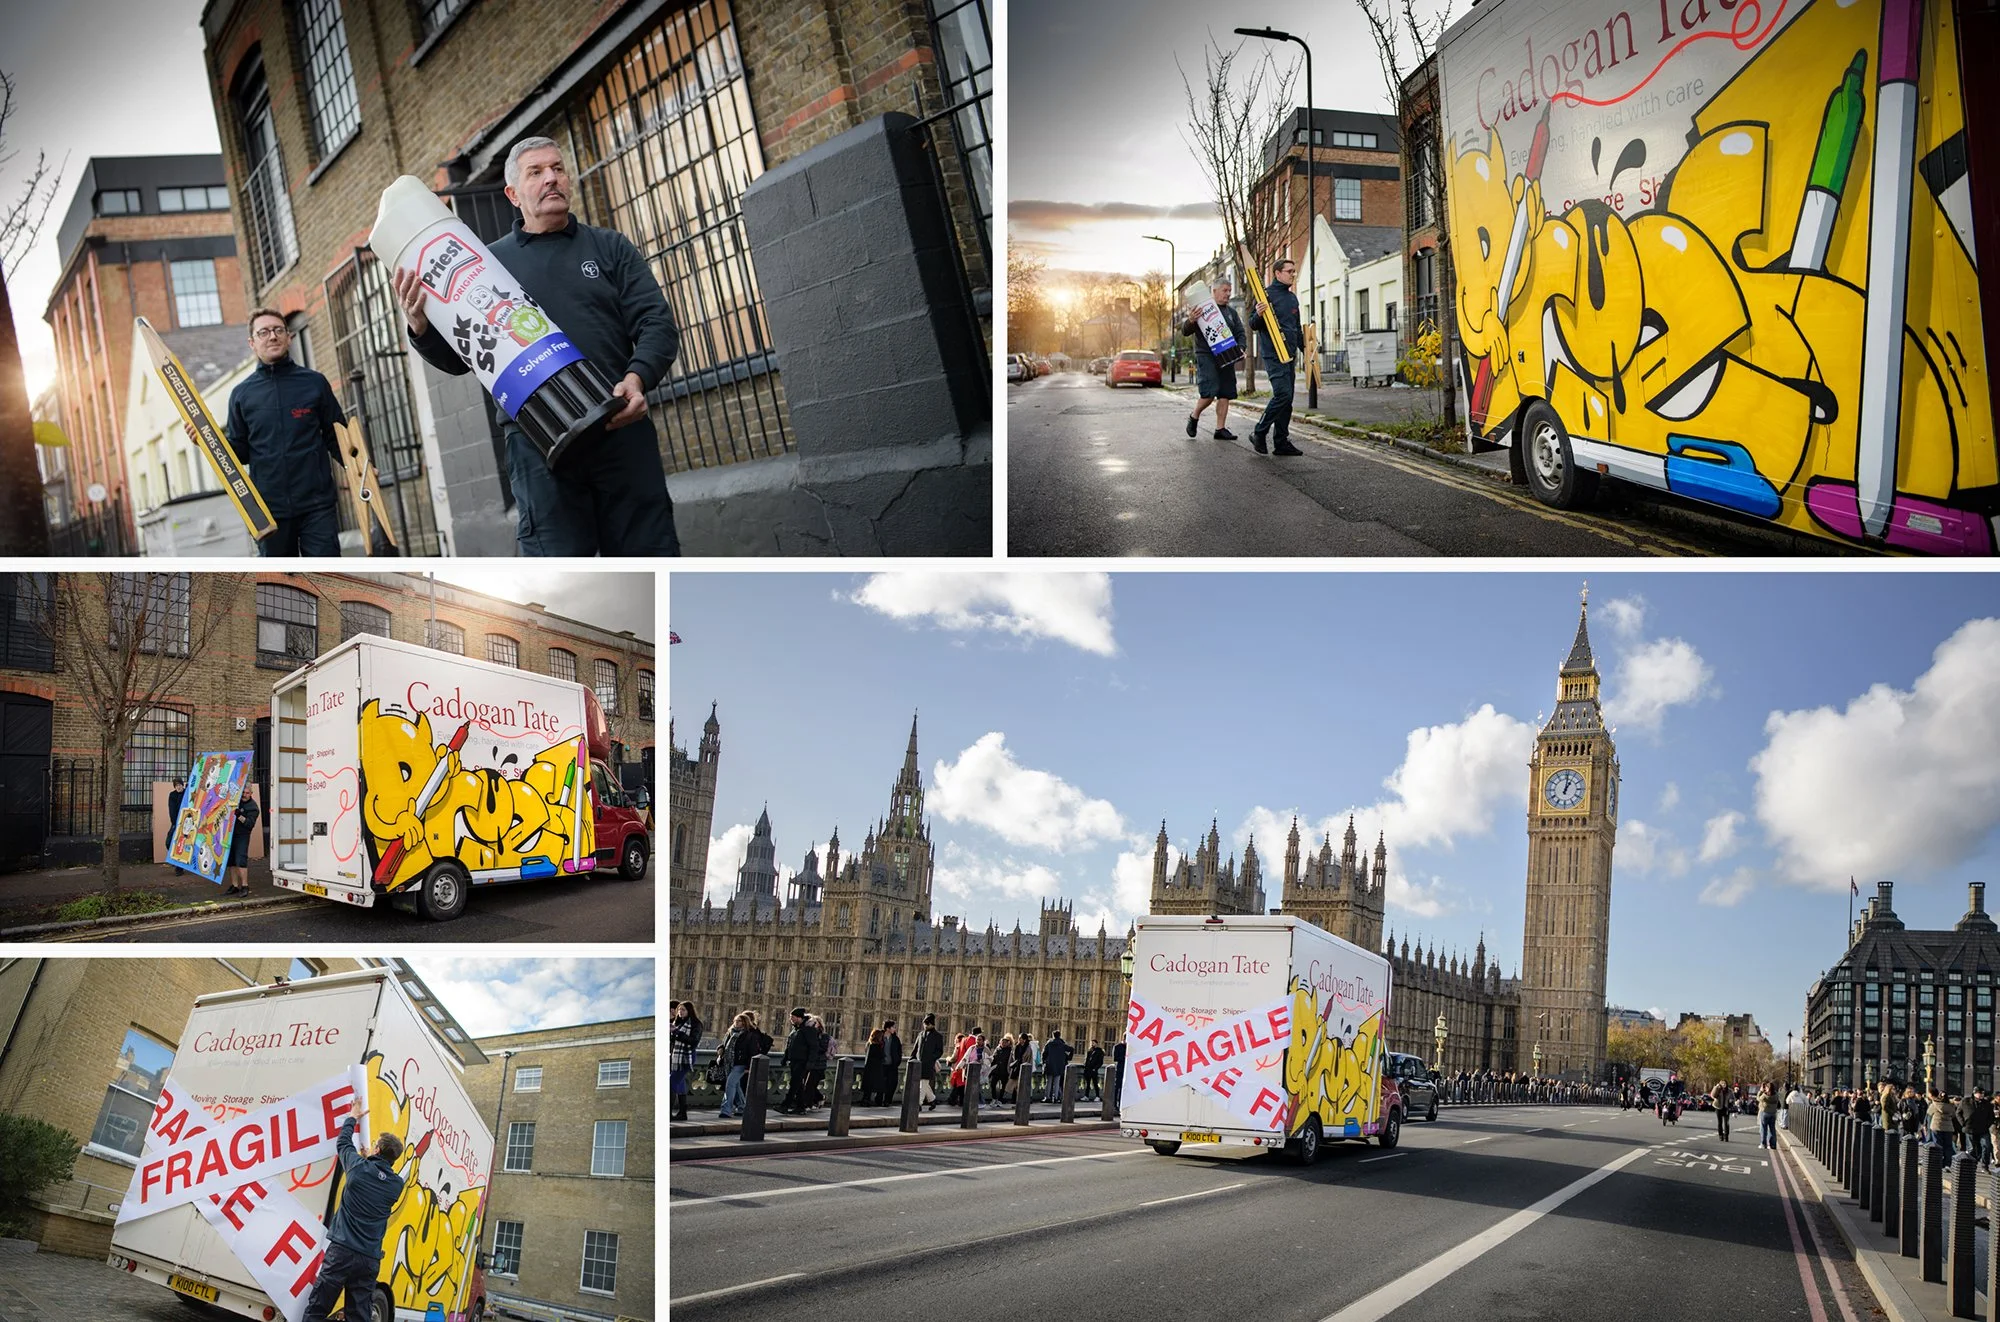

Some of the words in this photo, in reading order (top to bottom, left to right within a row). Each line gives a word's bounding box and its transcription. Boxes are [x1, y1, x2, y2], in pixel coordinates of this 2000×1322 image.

[1477, 10, 1638, 131] Cadogan
[1626, 92, 1660, 121] with
[1666, 78, 1704, 107] care
[422, 239, 464, 289] Priest
[453, 264, 487, 302] ORIGINAL
[518, 347, 553, 377] Solvent
[551, 341, 570, 352] Free
[164, 364, 200, 418] STAEDTLER
[200, 424, 218, 449] Noris
[213, 448, 236, 476] school
[233, 480, 248, 496] HB
[320, 691, 345, 712] Tate
[407, 681, 516, 731] Cadogan
[518, 700, 559, 733] Tate
[1150, 953, 1228, 978] Cadogan
[1231, 955, 1270, 974] Tate
[1309, 959, 1354, 1003] Cadogan
[1356, 976, 1374, 1006] Tate
[1190, 1006, 1218, 1016] Storage
[194, 1028, 282, 1056] Cadogan
[288, 1022, 340, 1047] Tate
[1134, 1006, 1291, 1091] FRAGILE
[222, 1095, 255, 1104] Storage
[402, 1058, 460, 1155] Cadogan
[460, 1129, 479, 1176] Tate
[140, 1085, 360, 1204] FRAGILE
[1653, 1157, 1751, 1174] BUS
[194, 1284, 210, 1299] CTL
